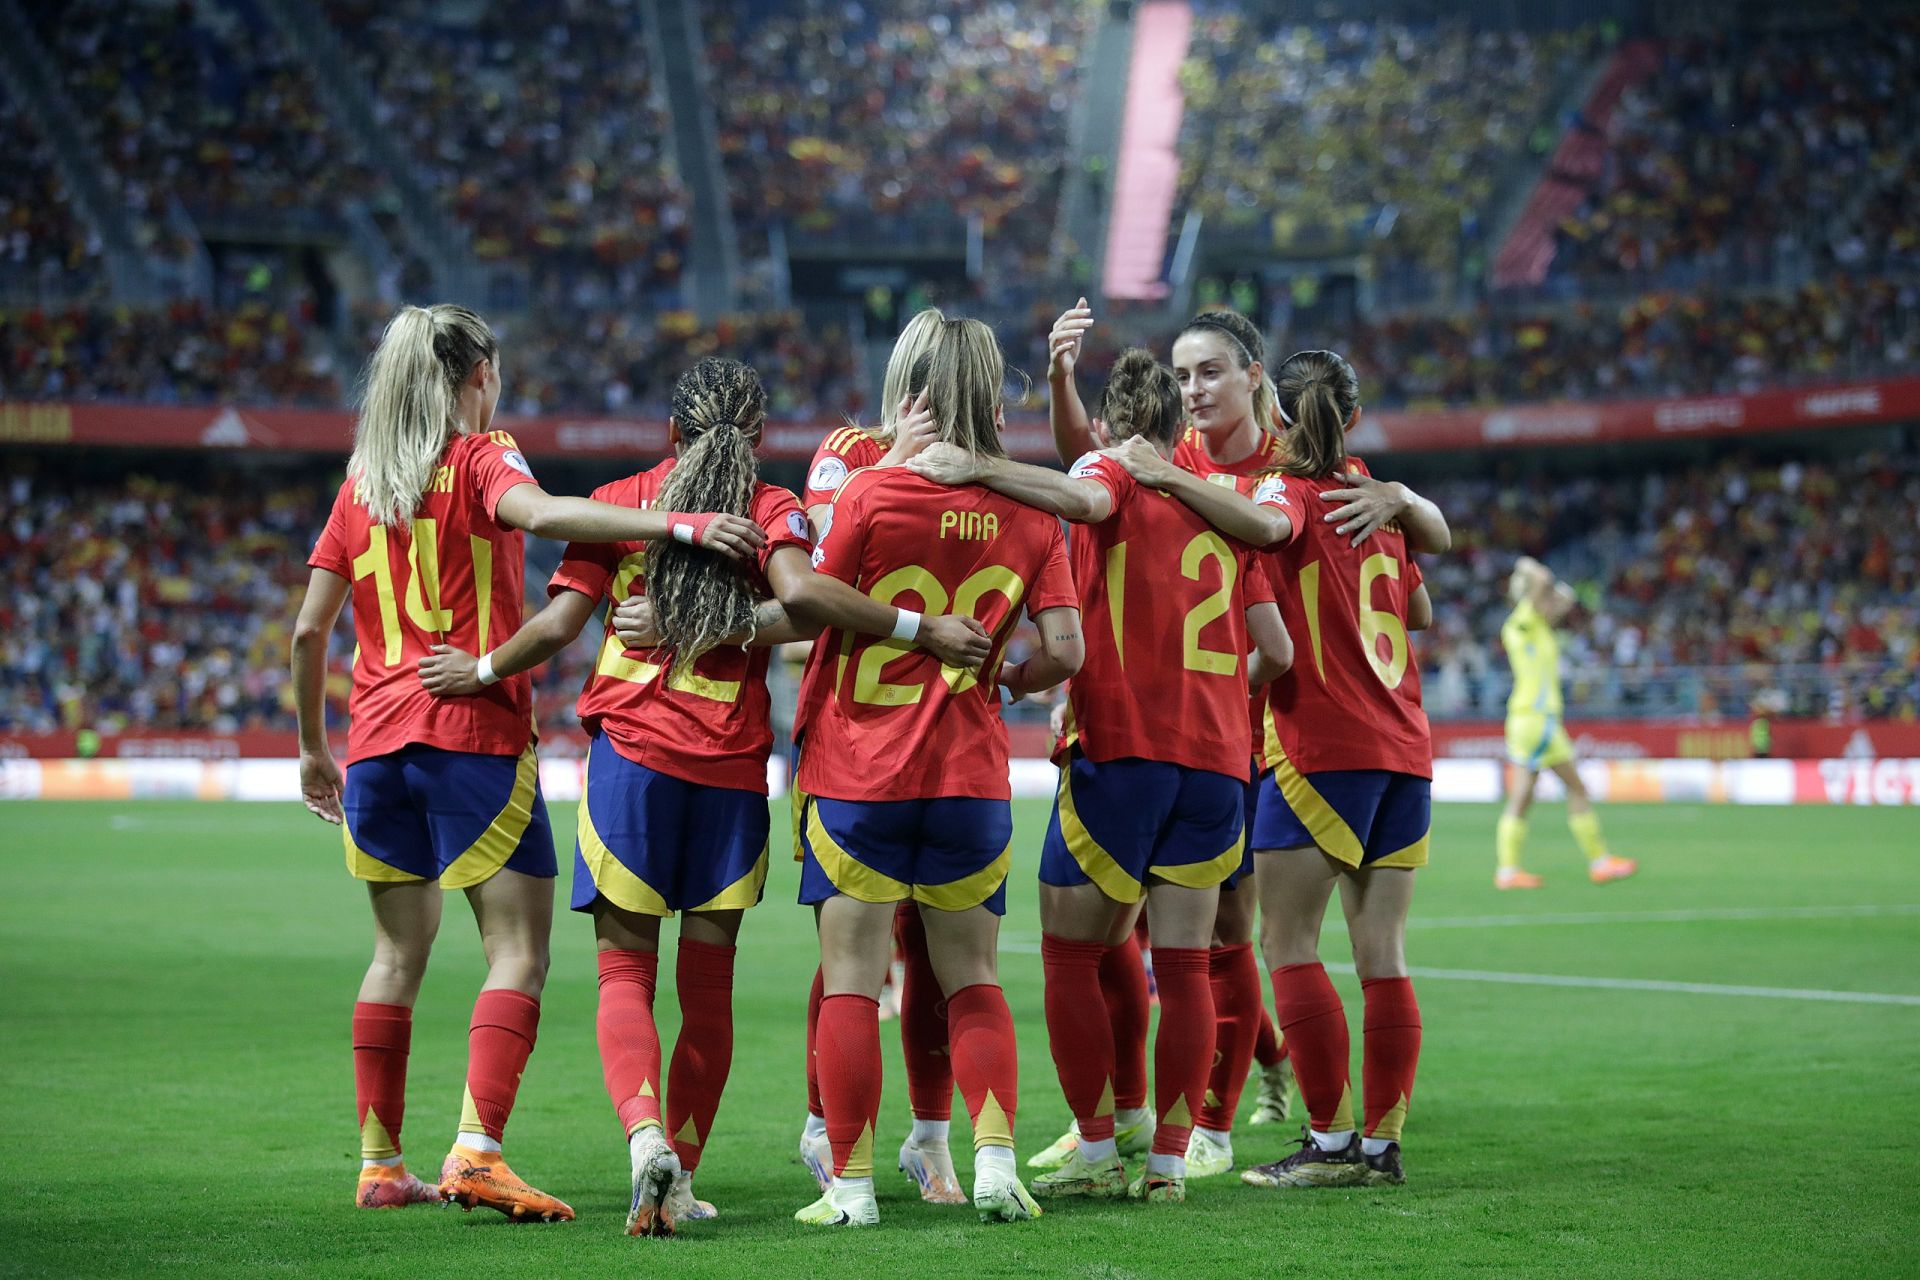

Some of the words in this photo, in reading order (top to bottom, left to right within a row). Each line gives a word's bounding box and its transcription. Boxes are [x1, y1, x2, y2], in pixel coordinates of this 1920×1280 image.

[352, 518, 454, 667] 14
[939, 510, 998, 541] PINA
[1181, 530, 1238, 677] 2
[1359, 552, 1408, 690] 6
